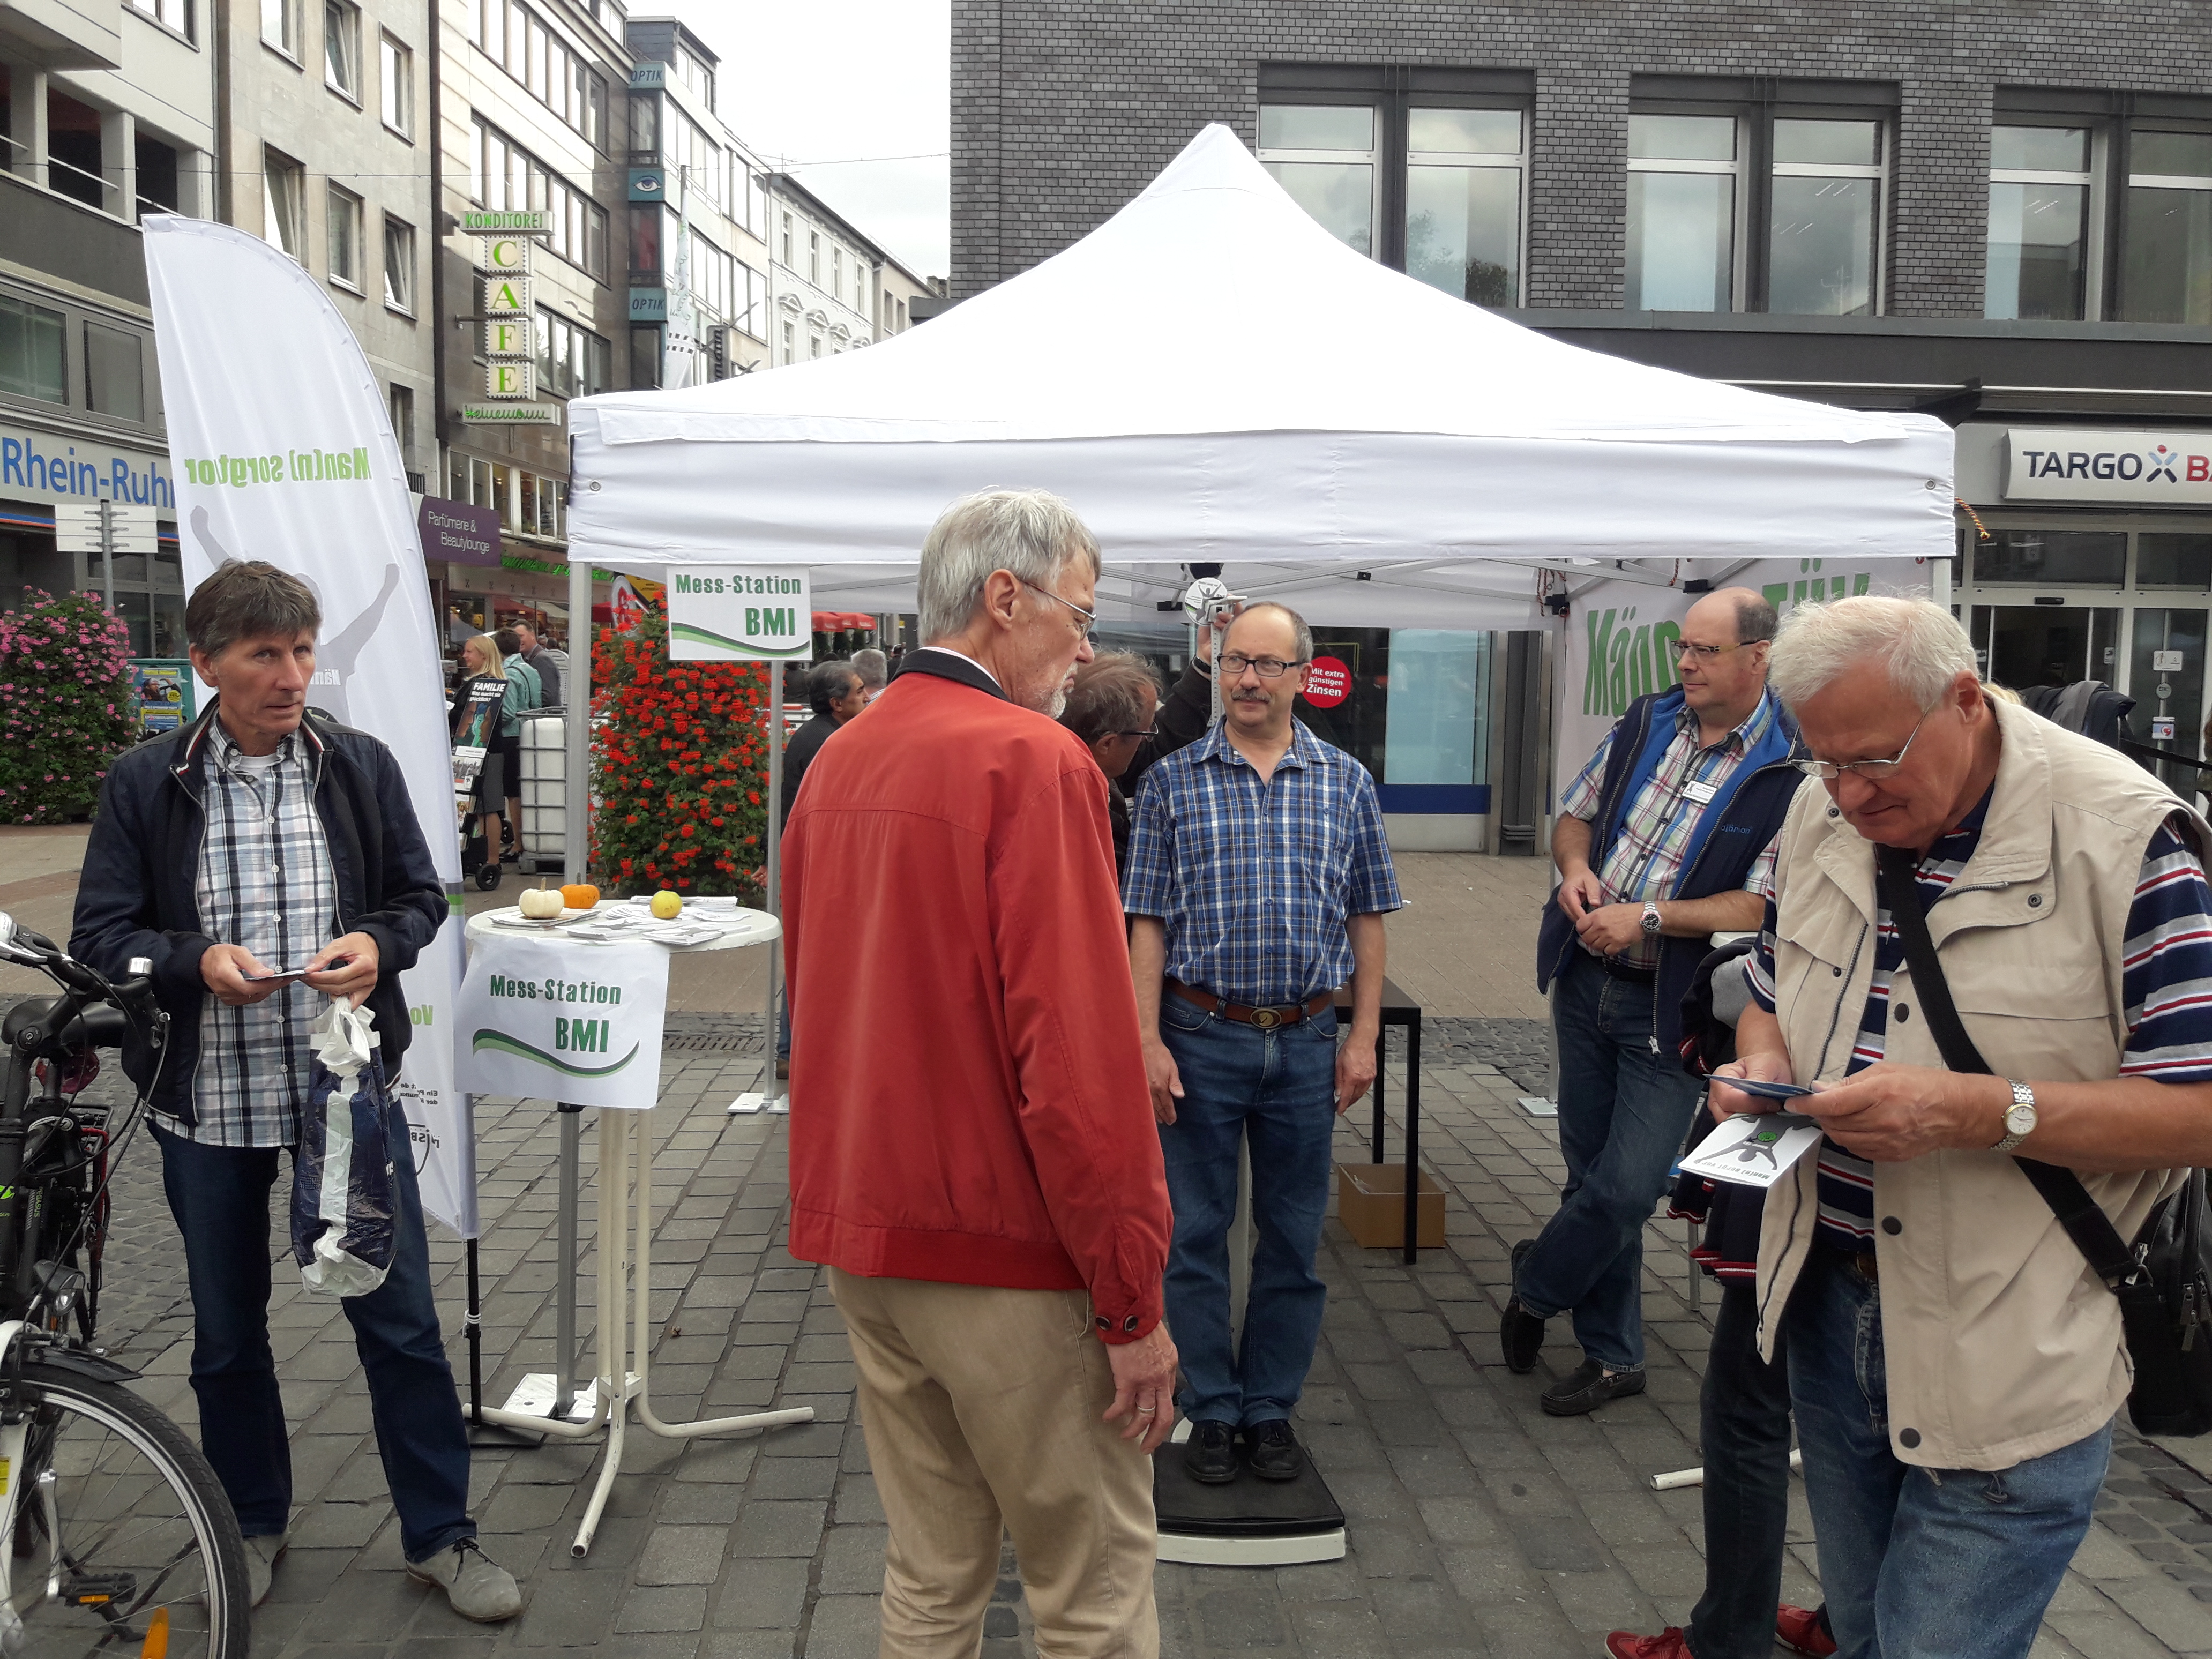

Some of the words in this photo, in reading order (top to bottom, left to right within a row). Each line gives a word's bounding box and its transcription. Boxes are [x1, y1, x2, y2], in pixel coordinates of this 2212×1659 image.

[630, 70, 663, 81] OPTIK
[466, 213, 543, 229] KONDITOREI
[632, 298, 665, 310] OPTIK
[490, 240, 522, 394] CAFE
[714, 328, 723, 382] mann
[2022, 451, 2142, 480] TARGO
[2185, 455, 2212, 482] B
[428, 511, 470, 532] Parfümerie
[440, 532, 490, 555] Beautylounge
[675, 574, 802, 594] Mess-Station
[745, 608, 796, 636] BMI
[1582, 605, 1681, 718] Männ
[1308, 676, 1343, 686] günstigen
[1311, 667, 1323, 675] Mit
[1325, 670, 1344, 678] extra
[473, 682, 506, 692] FAMILIE
[1306, 684, 1342, 697] Zinsen
[490, 975, 622, 1005] Mess-Station
[556, 1017, 610, 1053] BMI
